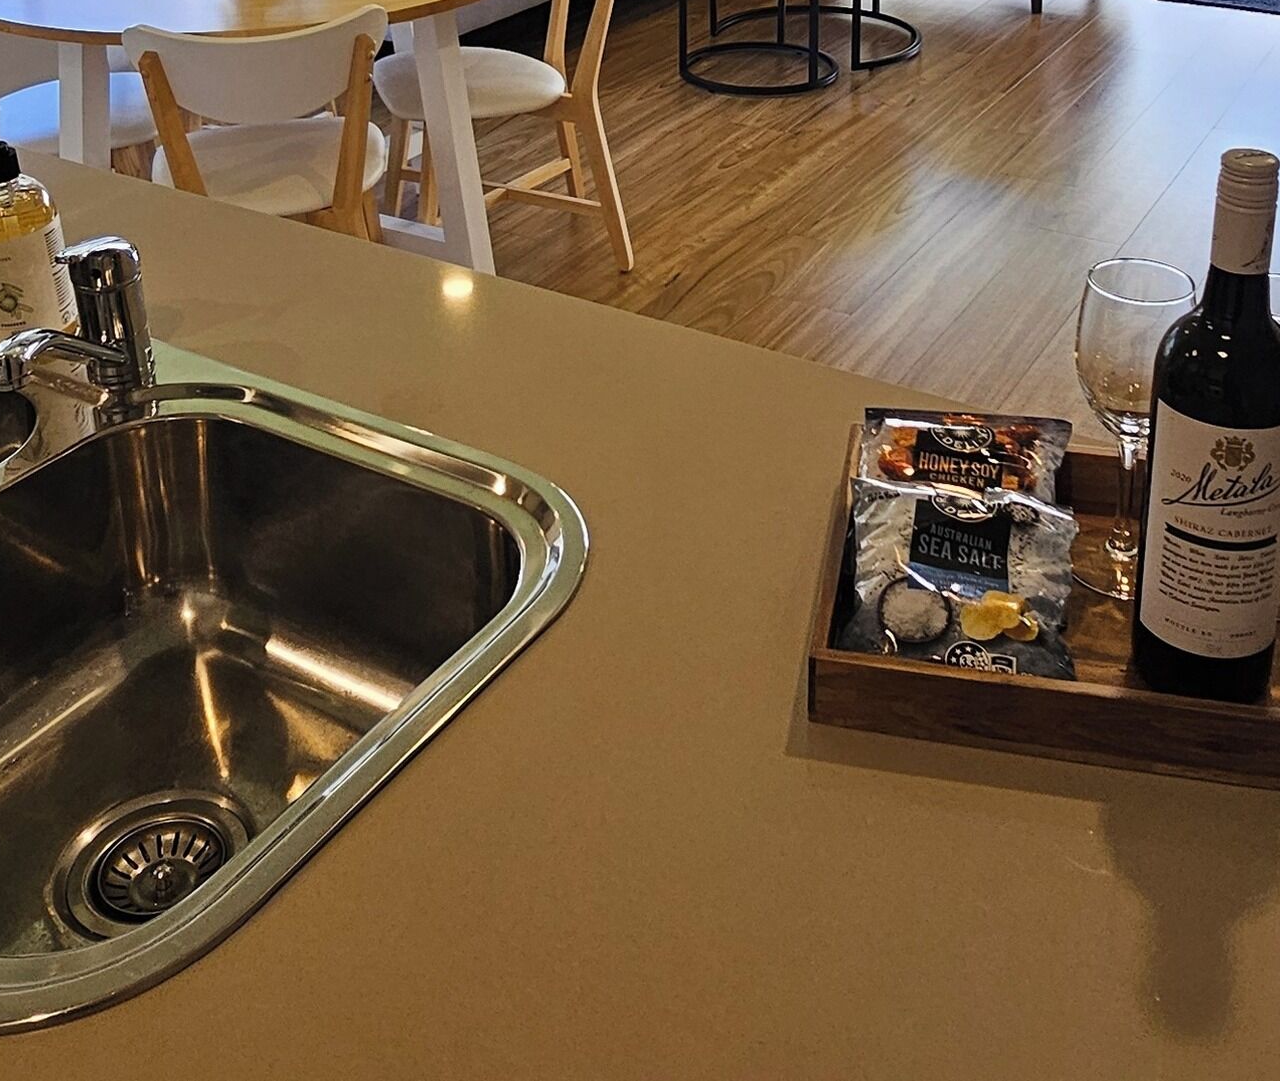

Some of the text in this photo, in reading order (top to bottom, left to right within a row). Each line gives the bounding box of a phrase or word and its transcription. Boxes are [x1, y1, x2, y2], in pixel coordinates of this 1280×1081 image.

[942, 436, 979, 450] DELI
[919, 452, 1001, 479] HONEY SOY
[1170, 468, 1192, 484] 2020
[929, 472, 986, 488] CHICKEN
[930, 523, 992, 550] AUSTRALIAN
[1173, 515, 1272, 538] SHIRAZ CABERNET
[918, 533, 1003, 570] SEA SALT
